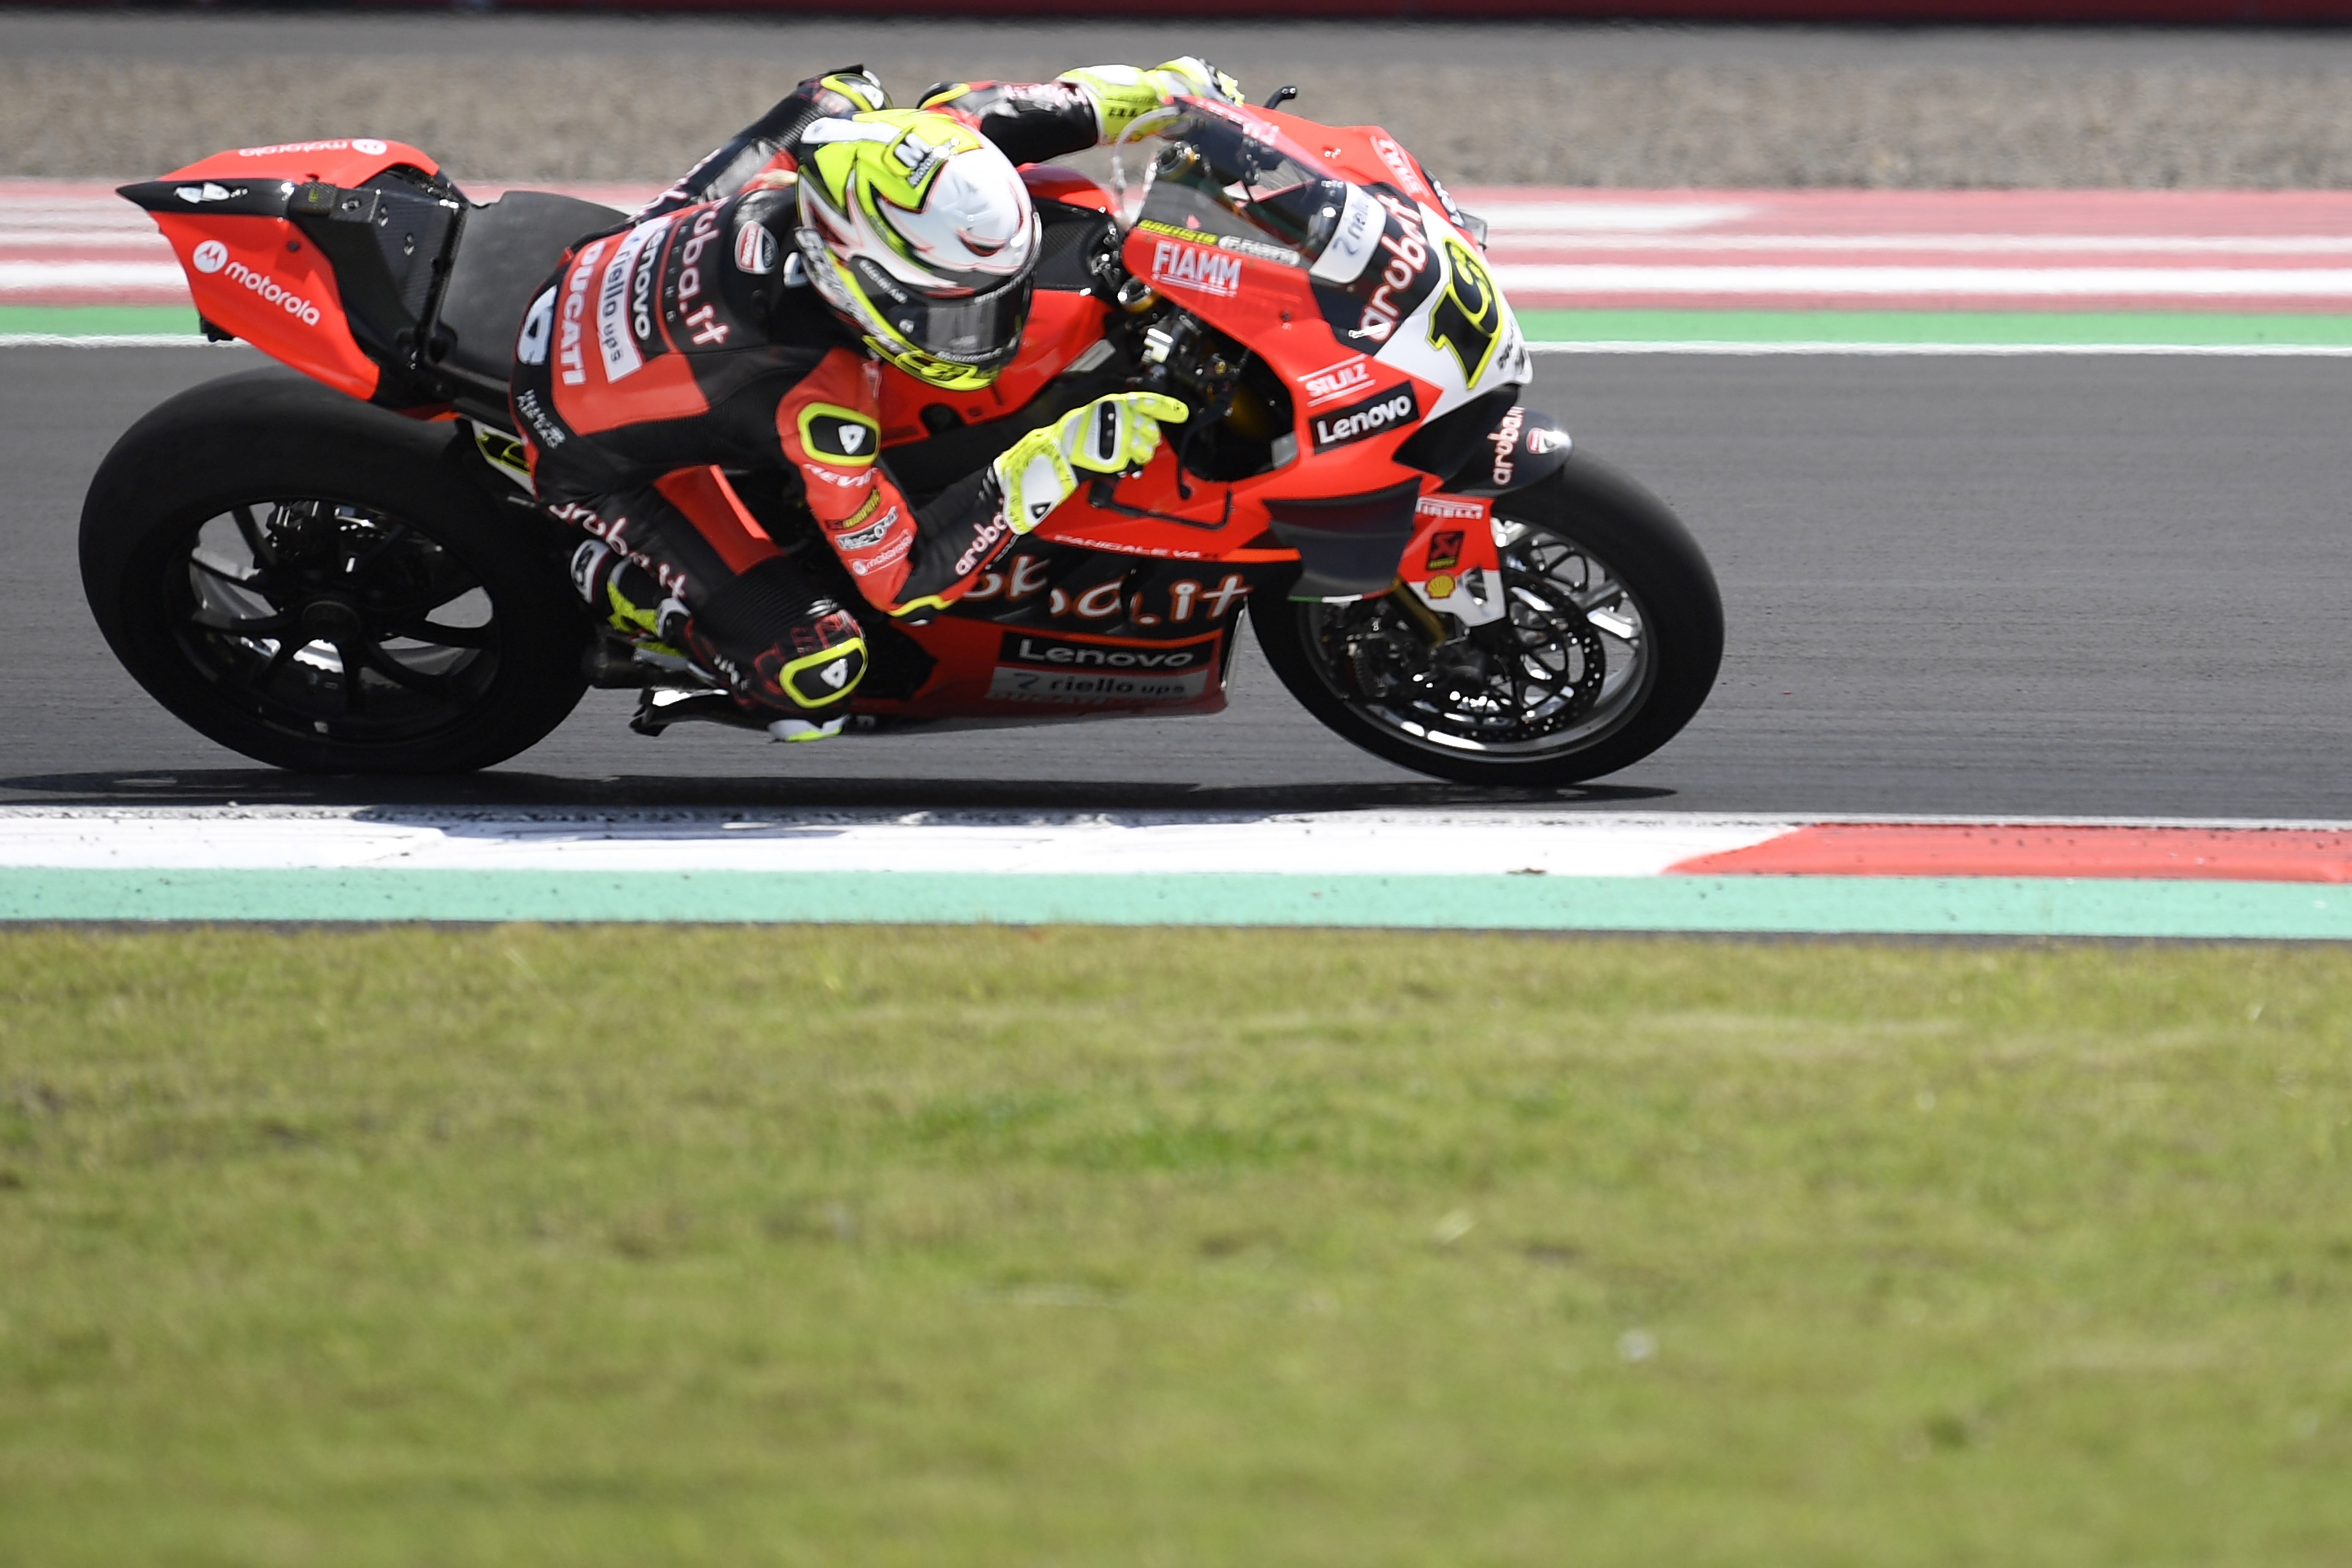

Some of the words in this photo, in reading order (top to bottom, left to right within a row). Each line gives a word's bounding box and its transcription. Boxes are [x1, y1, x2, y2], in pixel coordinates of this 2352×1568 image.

[604, 248, 629, 320] riello
[634, 230, 667, 340] enovo
[1153, 240, 1242, 291] FIAMM
[224, 261, 321, 327] motorola
[604, 326, 622, 364] ups
[1305, 362, 1371, 397] STULZ
[1317, 395, 1412, 444] Lenovo
[956, 507, 1007, 576] aruba
[1018, 638, 1195, 667] Lenovo
[1051, 676, 1134, 694] riello
[1142, 685, 1185, 696] ups
